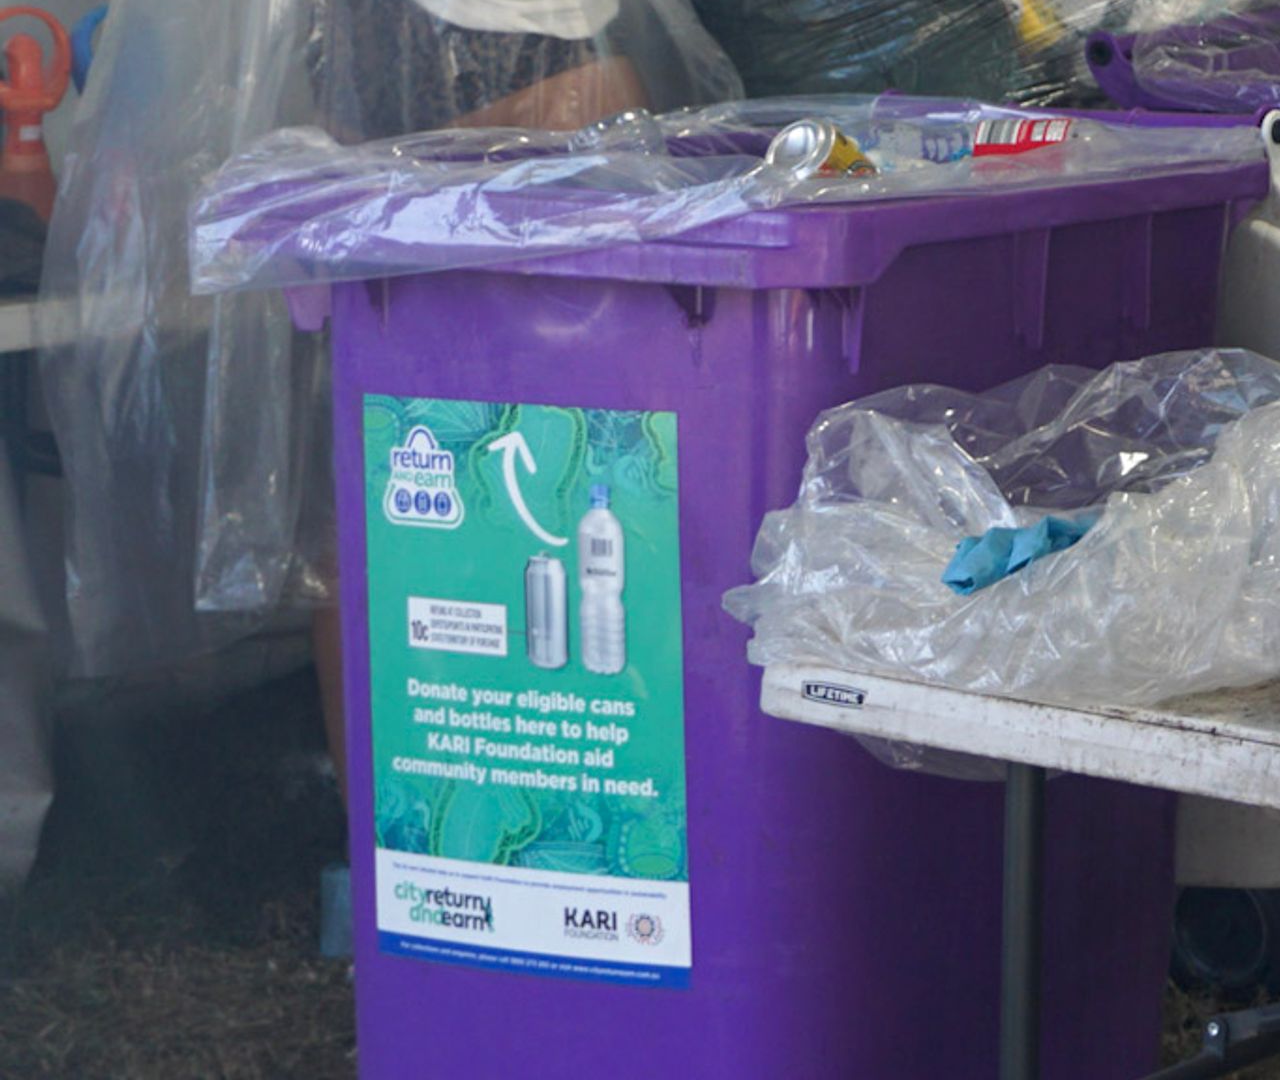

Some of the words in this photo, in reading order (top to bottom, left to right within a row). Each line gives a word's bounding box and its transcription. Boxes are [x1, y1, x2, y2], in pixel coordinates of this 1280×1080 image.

[393, 449, 452, 471] return
[414, 471, 452, 489] earn
[407, 677, 468, 700] Donate
[472, 689, 513, 707] your
[517, 690, 586, 714] eligible
[590, 699, 636, 717] cans
[413, 706, 446, 724] and
[449, 708, 512, 733] bottles
[515, 715, 558, 737] here
[561, 720, 582, 738] to
[586, 721, 630, 746] help
[427, 732, 470, 754] KARI
[474, 736, 580, 765] Foundation
[583, 749, 614, 767] aid
[392, 756, 487, 785] community
[491, 768, 577, 792] members
[581, 773, 600, 793] in
[603, 778, 659, 798] need.
[564, 906, 617, 931] KARI
